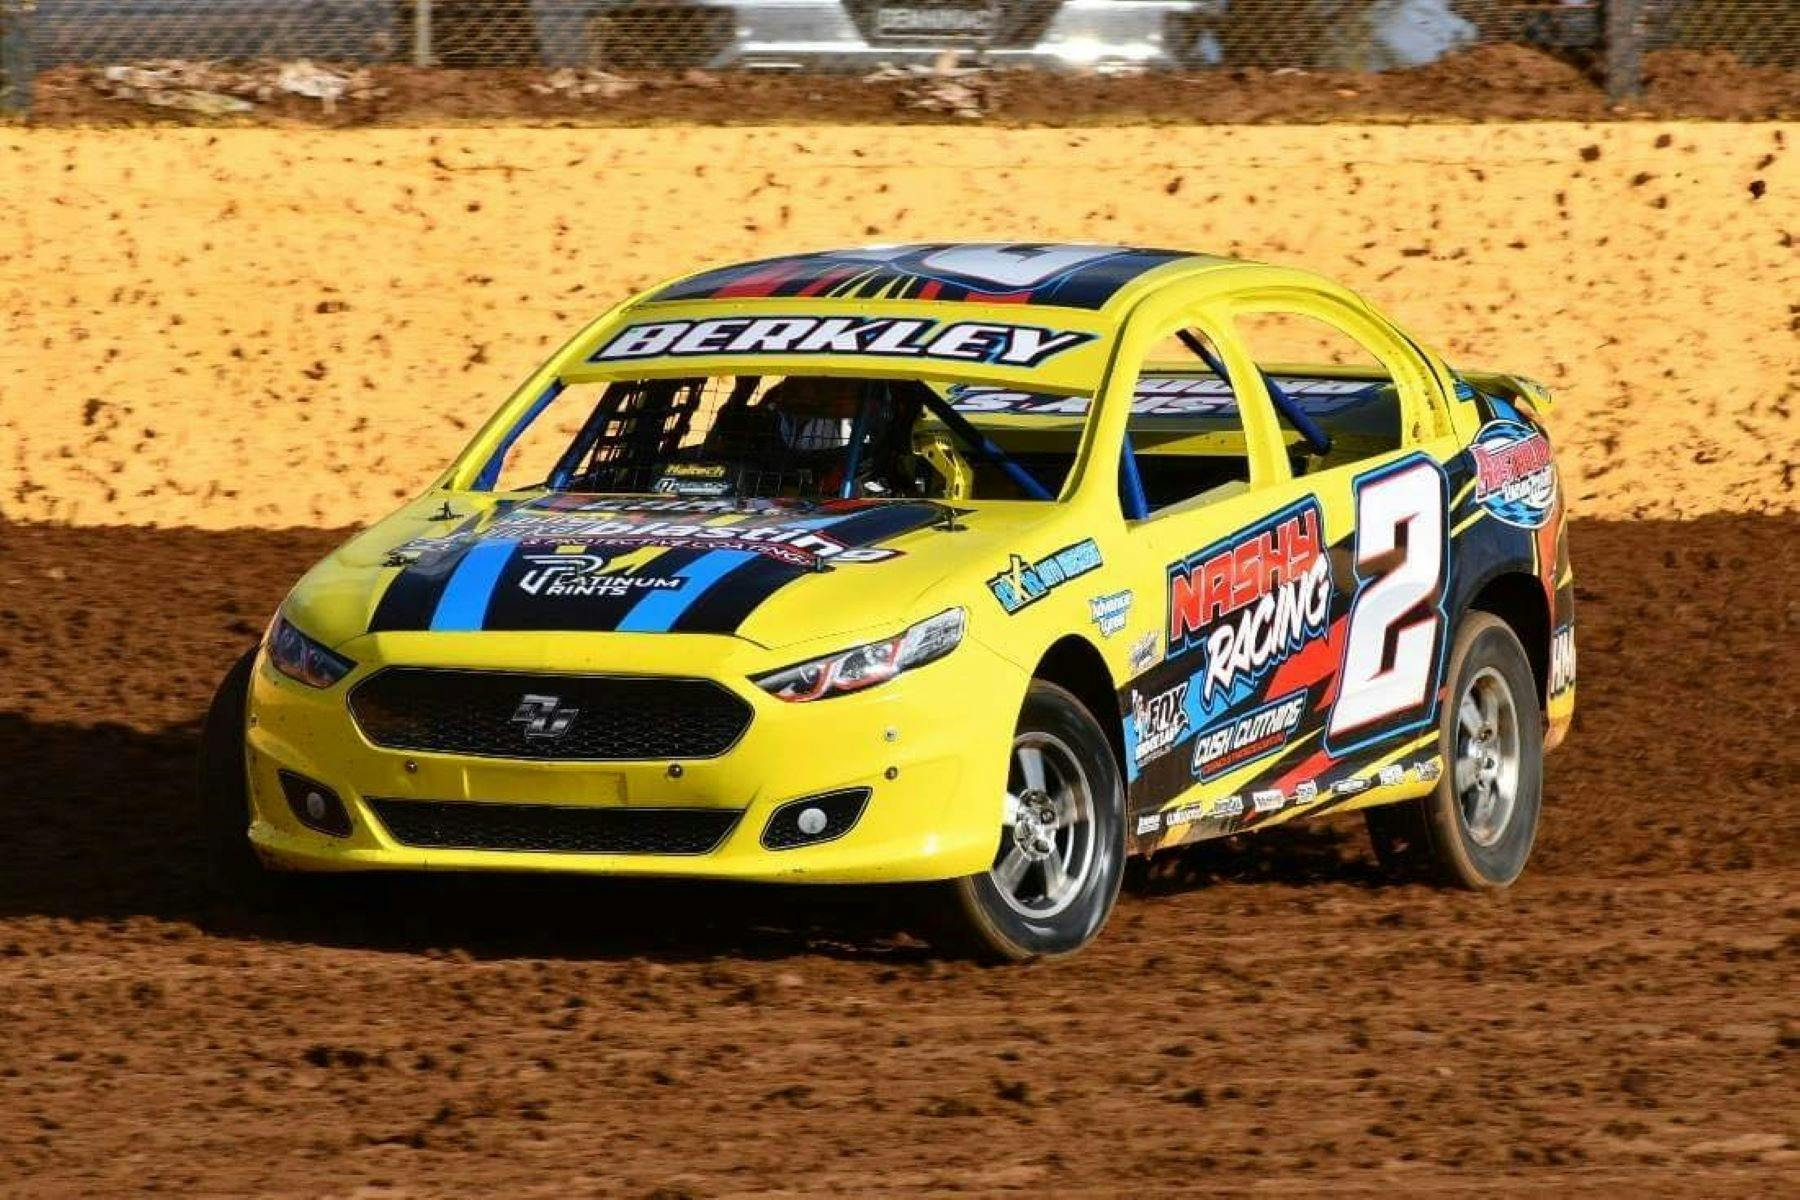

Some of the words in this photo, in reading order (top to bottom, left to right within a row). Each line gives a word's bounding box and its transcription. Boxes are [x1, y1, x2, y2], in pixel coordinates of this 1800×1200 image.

[594, 317, 1082, 364] BERKLEY
[1170, 508, 1319, 642] NASHY
[1204, 552, 1330, 700] RACING
[1327, 462, 1442, 738] 2
